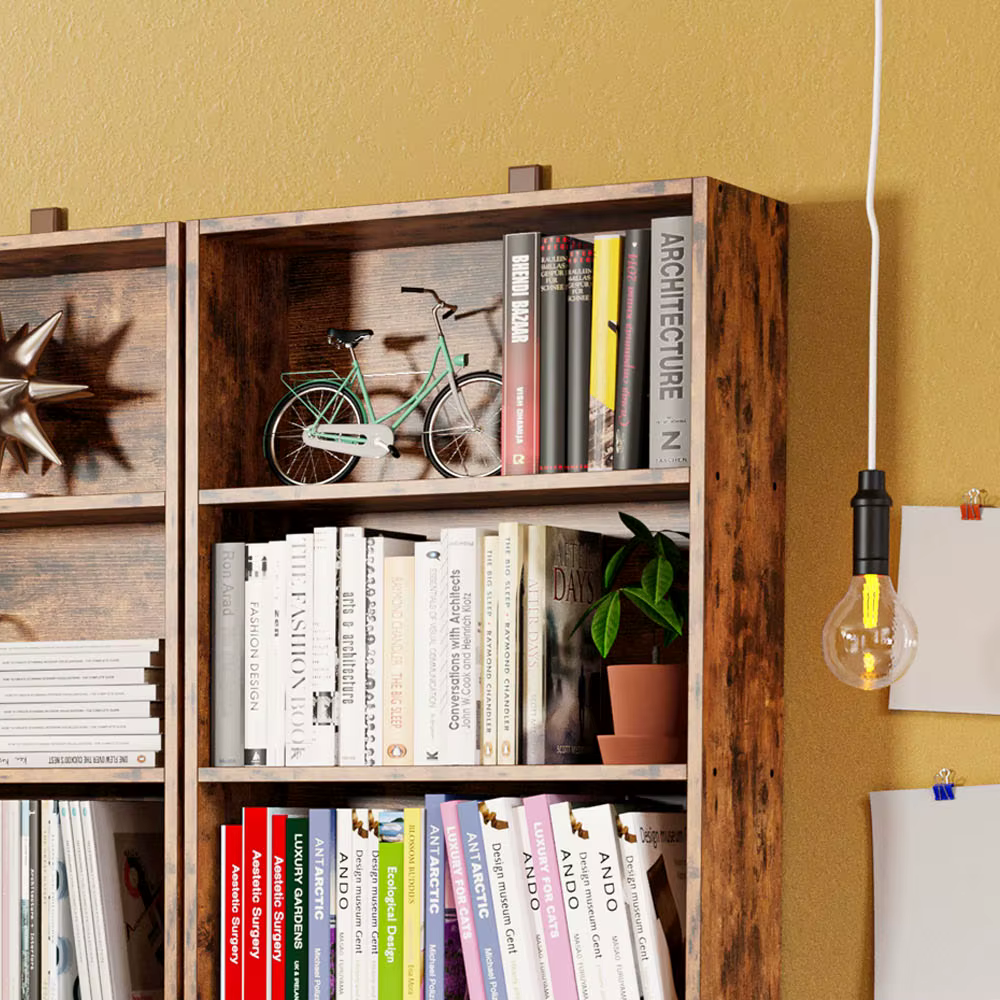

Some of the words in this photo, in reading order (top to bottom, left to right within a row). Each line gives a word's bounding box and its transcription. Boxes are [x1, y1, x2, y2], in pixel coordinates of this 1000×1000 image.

[512, 255, 529, 296] BHENDI
[511, 301, 529, 343] BAZAAR
[659, 233, 684, 400] ARCHITECTURE
[222, 551, 234, 577] Ron
[291, 537, 306, 585] THE
[554, 567, 595, 602] DAYS
[222, 584, 234, 616] Arad
[343, 592, 354, 614] arts
[450, 569, 460, 624] Architects
[463, 593, 472, 612] Klotz
[250, 602, 259, 658] FASHION
[291, 592, 306, 690] FASHION
[450, 626, 459, 650] with
[462, 615, 471, 650] Heinrich
[343, 634, 356, 704] architecture
[462, 653, 471, 670] and
[250, 664, 259, 711] DESIGN
[449, 652, 459, 730] Conversations
[291, 697, 306, 761] BOOK
[462, 708, 471, 728] John
[294, 834, 303, 885] LUXURY
[353, 850, 363, 879] Design
[429, 825, 439, 914] ANTARCTIC
[533, 822, 549, 872] LUXURY
[579, 852, 590, 886] Design
[231, 864, 241, 913] Aestetic
[252, 850, 262, 903] Aestetic
[314, 837, 324, 920] ANTARCTIC
[339, 852, 349, 910] ANDO
[385, 866, 397, 922] Ecological
[466, 832, 489, 919] ANTARCTIC
[492, 843, 503, 878] Design
[498, 881, 511, 925] museum
[506, 928, 516, 954] Gent
[523, 852, 540, 911] ANDO
[542, 877, 553, 902] FOR
[561, 849, 580, 910] ANDO
[599, 852, 618, 912] ANDO
[250, 907, 262, 959] Surgery
[294, 888, 303, 949] GARDENS
[546, 906, 559, 938] CATS
[584, 889, 597, 931] museum
[230, 917, 241, 964] Surgery
[385, 926, 397, 963] Design
[592, 934, 602, 958] Gent
[294, 961, 300, 970] UK
